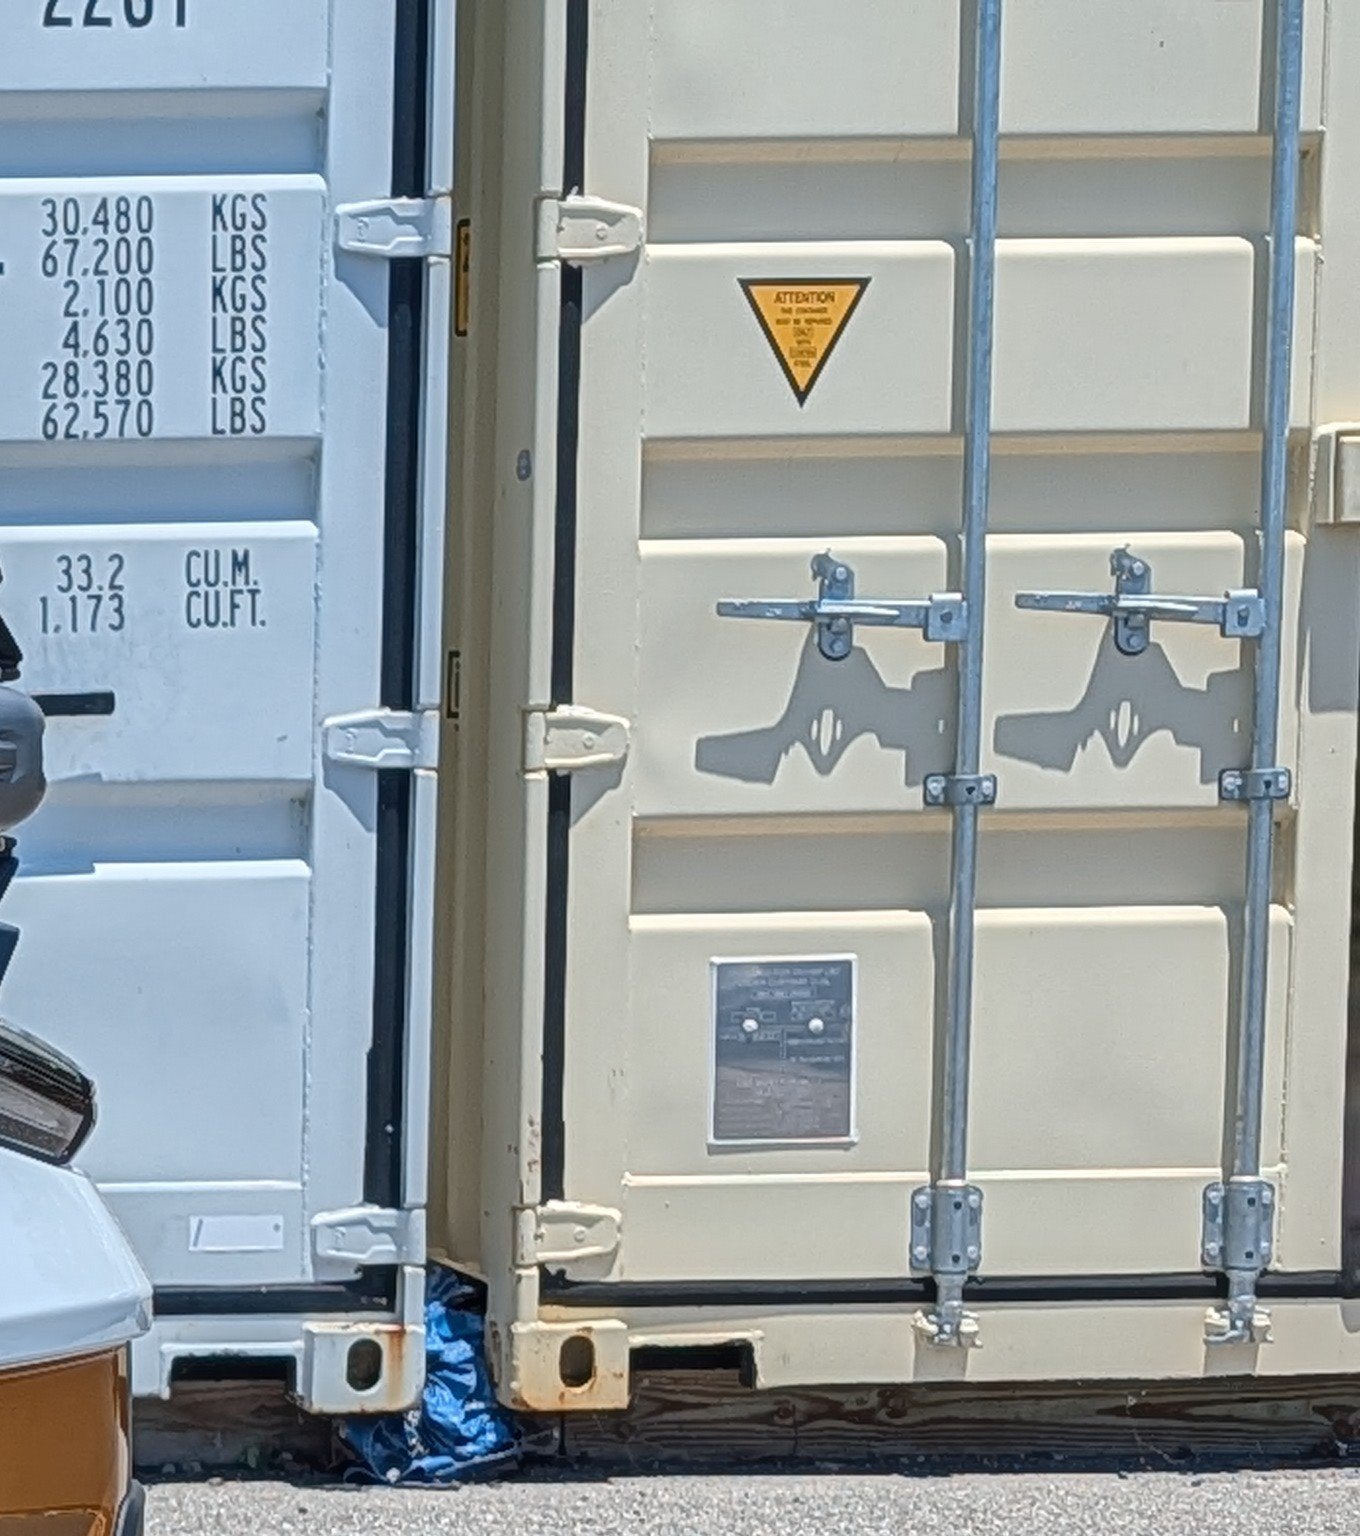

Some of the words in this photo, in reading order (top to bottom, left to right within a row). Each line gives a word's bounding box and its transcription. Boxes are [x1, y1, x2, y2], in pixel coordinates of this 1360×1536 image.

[41, 195, 154, 237] 30,480
[211, 193, 267, 232] KGS
[41, 236, 154, 278] 67,200
[211, 234, 267, 273] LBS
[62, 277, 154, 318] 2,100
[211, 275, 267, 314] KGS
[61, 318, 154, 358] 4,630
[211, 315, 267, 354] LBS
[41, 358, 154, 400] 28,380
[211, 355, 267, 394] KGS
[41, 399, 154, 440] 62,570
[211, 396, 267, 435] LBS
[56, 553, 125, 593] 33.2
[185, 548, 258, 588] CU.M.
[185, 588, 266, 629] CU.FT.
